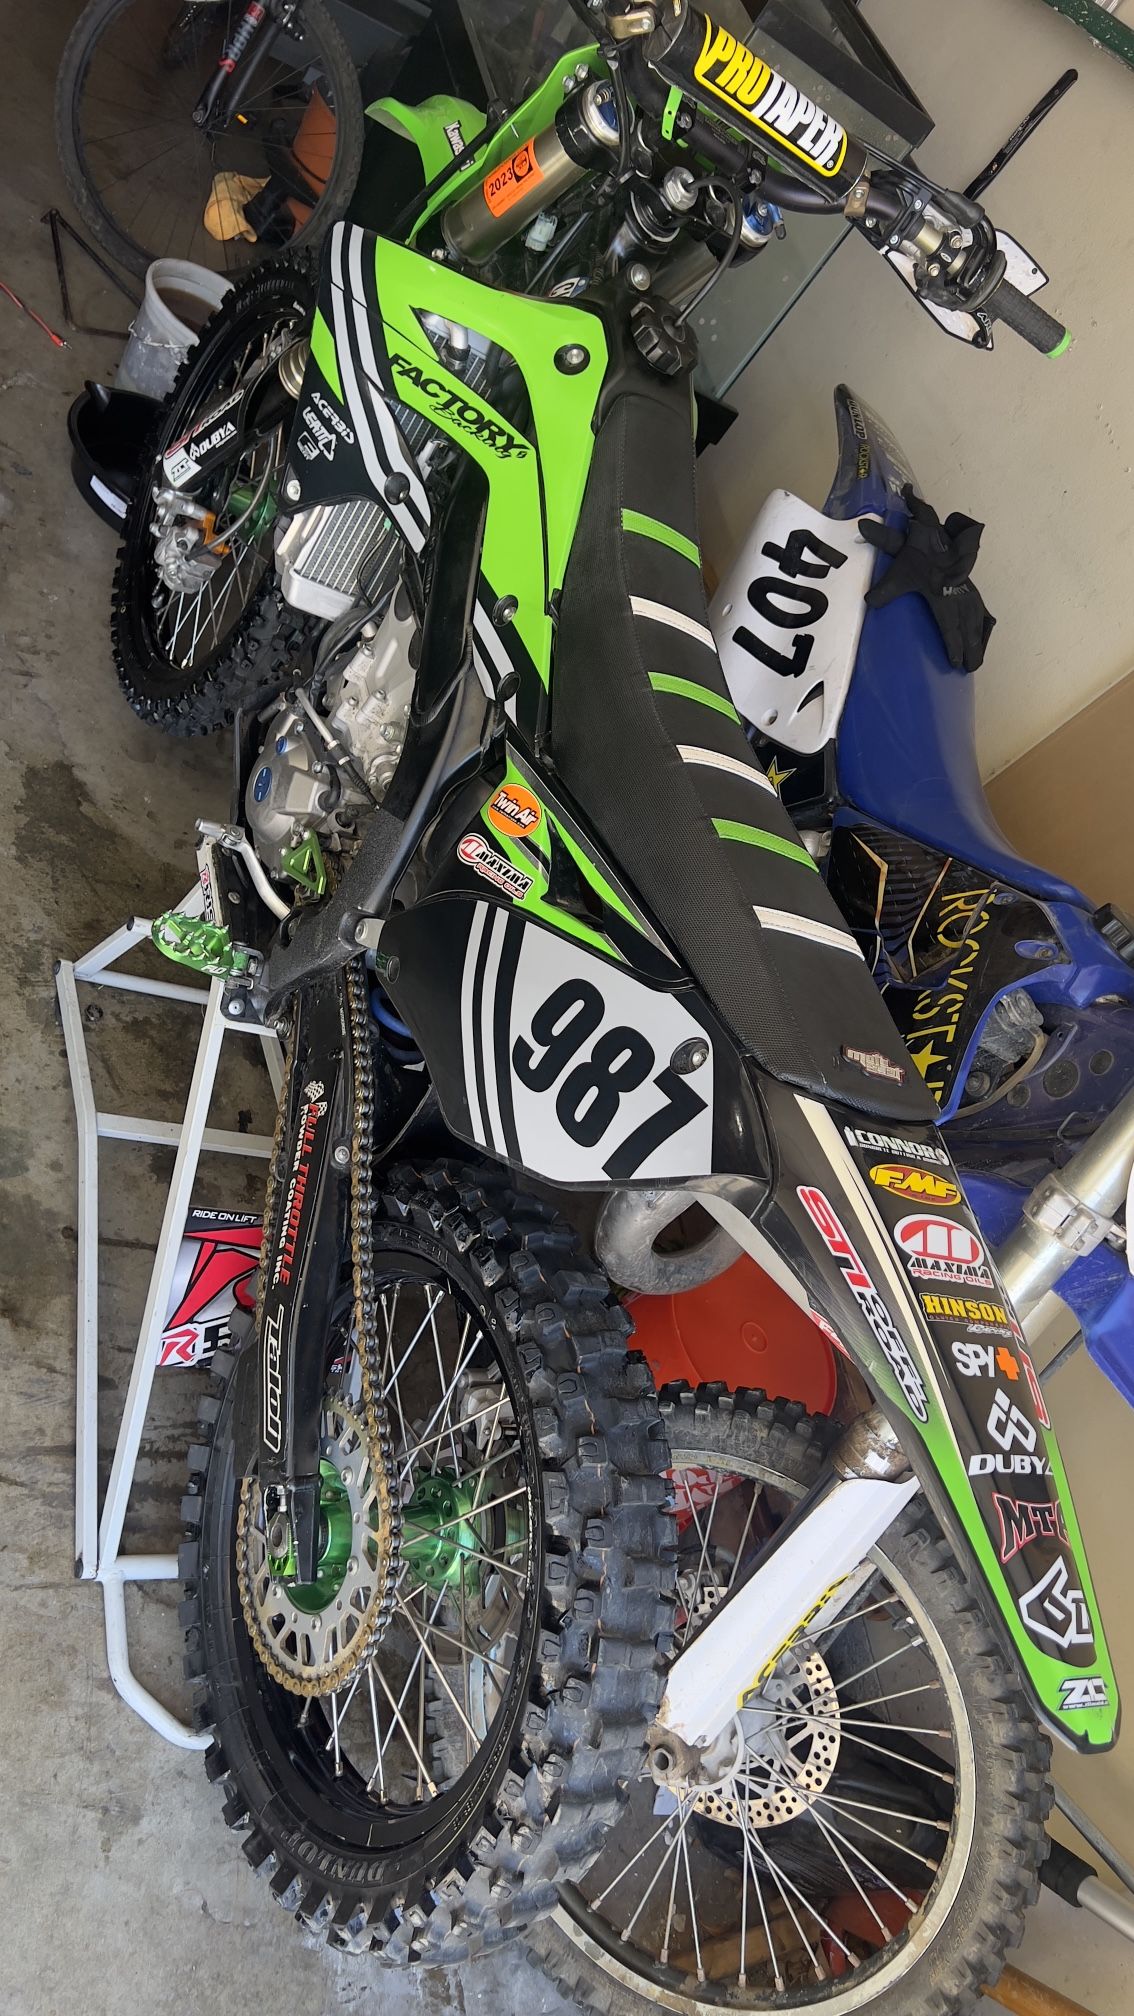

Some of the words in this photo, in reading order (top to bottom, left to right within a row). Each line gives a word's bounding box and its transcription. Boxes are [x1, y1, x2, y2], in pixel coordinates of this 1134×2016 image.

[444, 121, 475, 171] Kawasi
[489, 167, 514, 197] 2023
[390, 353, 530, 453] FACTORY
[199, 421, 236, 456] DUBYA
[732, 529, 848, 678] 407
[492, 790, 519, 817] Twin
[515, 807, 538, 828] Air
[474, 850, 532, 890] MAXIMA
[512, 978, 708, 1180] 987
[292, 1103, 309, 1172] POWDER
[302, 1103, 320, 1157] FULL
[854, 1129, 937, 1160] CONNOR
[874, 1168, 958, 1198] FMF
[191, 1209, 217, 1220] RIDE
[218, 1213, 235, 1222] ON
[235, 1214, 258, 1225] LIFT
[279, 1178, 297, 1250] COATING
[280, 1163, 309, 1286] THROTTLE
[271, 1254, 284, 1290] INC.
[909, 1256, 991, 1280] MAXIMA
[913, 1268, 962, 1282] RACING
[963, 1276, 993, 1287] OILS
[921, 1295, 1008, 1325] HINSON
[951, 1341, 995, 1378] SPY
[264, 1304, 284, 1453] Talon
